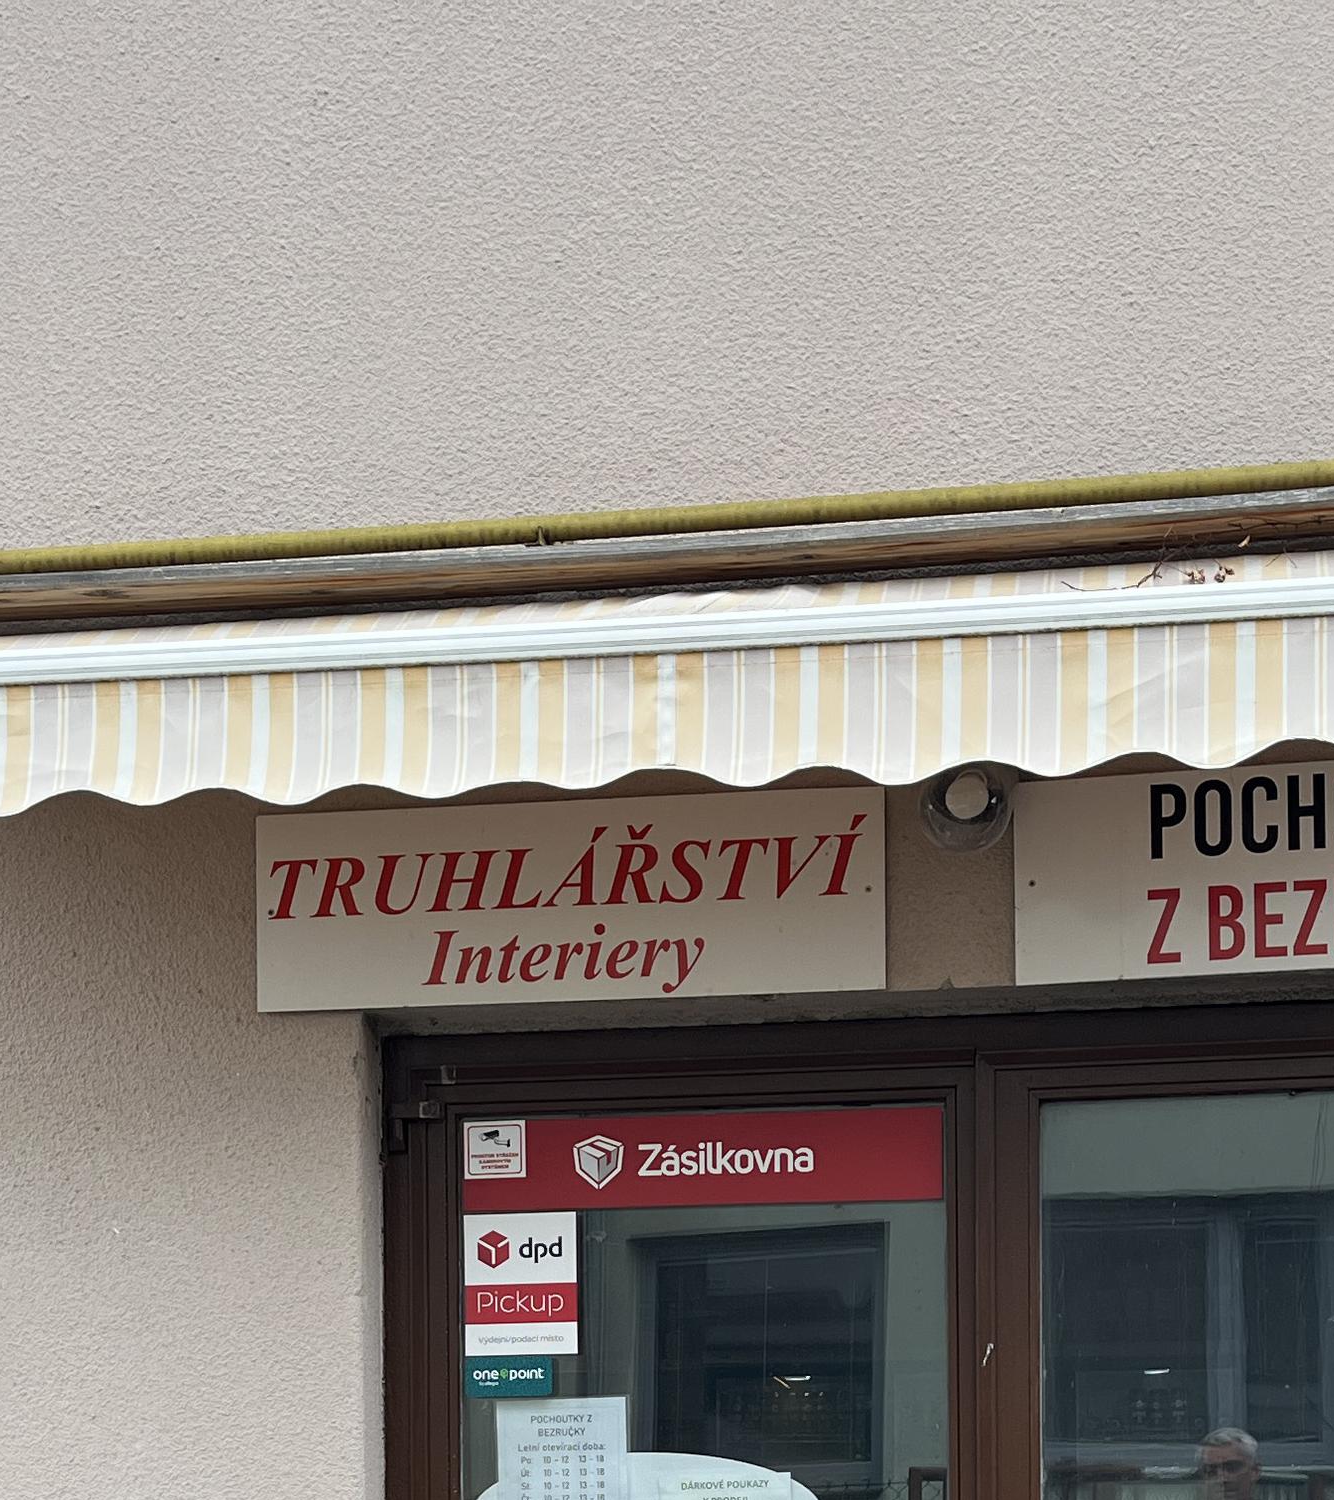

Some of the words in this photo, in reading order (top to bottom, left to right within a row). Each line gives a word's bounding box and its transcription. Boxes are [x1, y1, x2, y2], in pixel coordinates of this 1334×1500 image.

[267, 813, 868, 920] TRUHLÁŘSTVÍ
[1146, 887, 1182, 965] Z
[421, 923, 706, 994] Interiery
[637, 1141, 815, 1178] Zásilkovna
[518, 1235, 563, 1264] dpd
[476, 1289, 564, 1317] Pickup
[472, 1369, 500, 1380] one
[509, 1368, 545, 1381] point
[530, 1414, 585, 1424] POCHOUTKY
[587, 1414, 593, 1423] Z
[537, 1427, 586, 1437] BEZRUČKY
[681, 1480, 724, 1490] DÁRKOVÉ
[726, 1480, 770, 1489] POUKAZY
